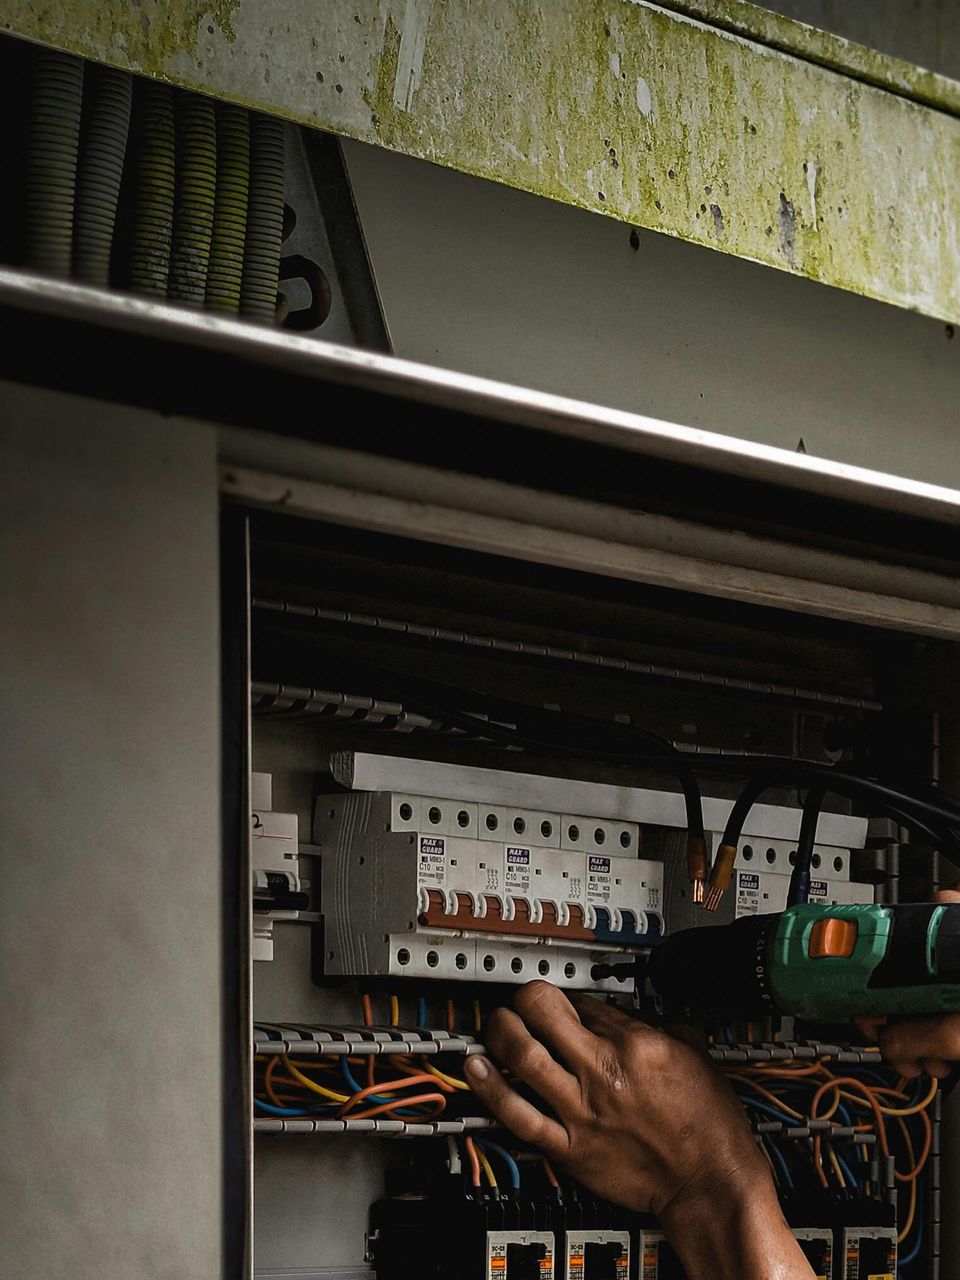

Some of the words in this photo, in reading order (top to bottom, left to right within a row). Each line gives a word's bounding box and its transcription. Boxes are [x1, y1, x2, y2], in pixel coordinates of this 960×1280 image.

[422, 838, 437, 846] MAX
[421, 846, 443, 854] GUARD
[508, 848, 523, 856] MAX
[508, 856, 528, 864] GUARD
[590, 857, 604, 865] MAX
[588, 883, 598, 891] C20
